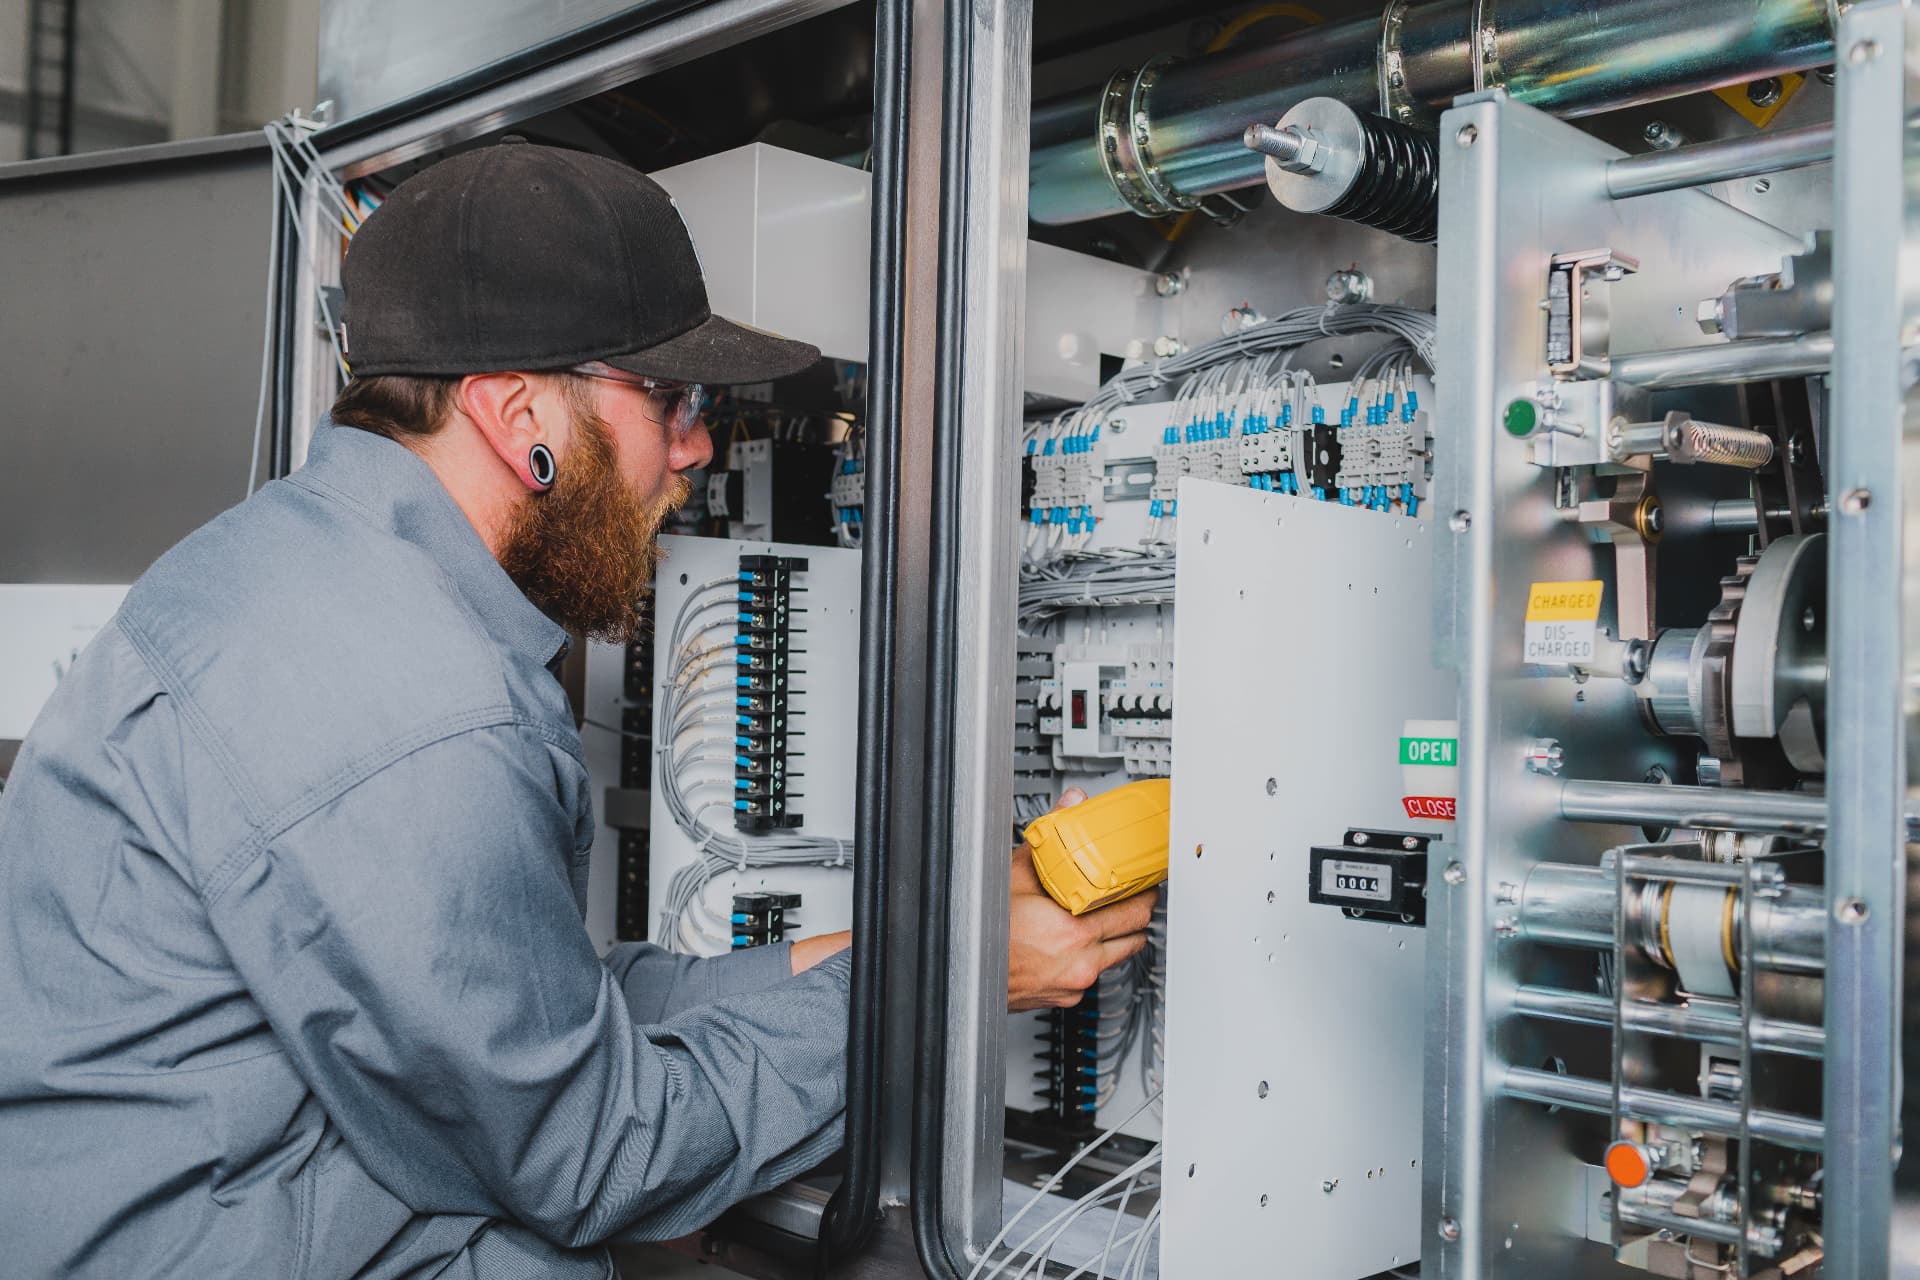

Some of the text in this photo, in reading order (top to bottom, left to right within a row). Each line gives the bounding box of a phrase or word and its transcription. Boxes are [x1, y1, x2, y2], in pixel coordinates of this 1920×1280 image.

[1533, 593, 1595, 609] CHARGED
[1544, 625, 1575, 641] DIS-
[1528, 641, 1591, 657] CHARGED
[1408, 741, 1452, 762] OPEN
[1407, 799, 1456, 817] CLOSE
[1338, 877, 1378, 891] 0004
